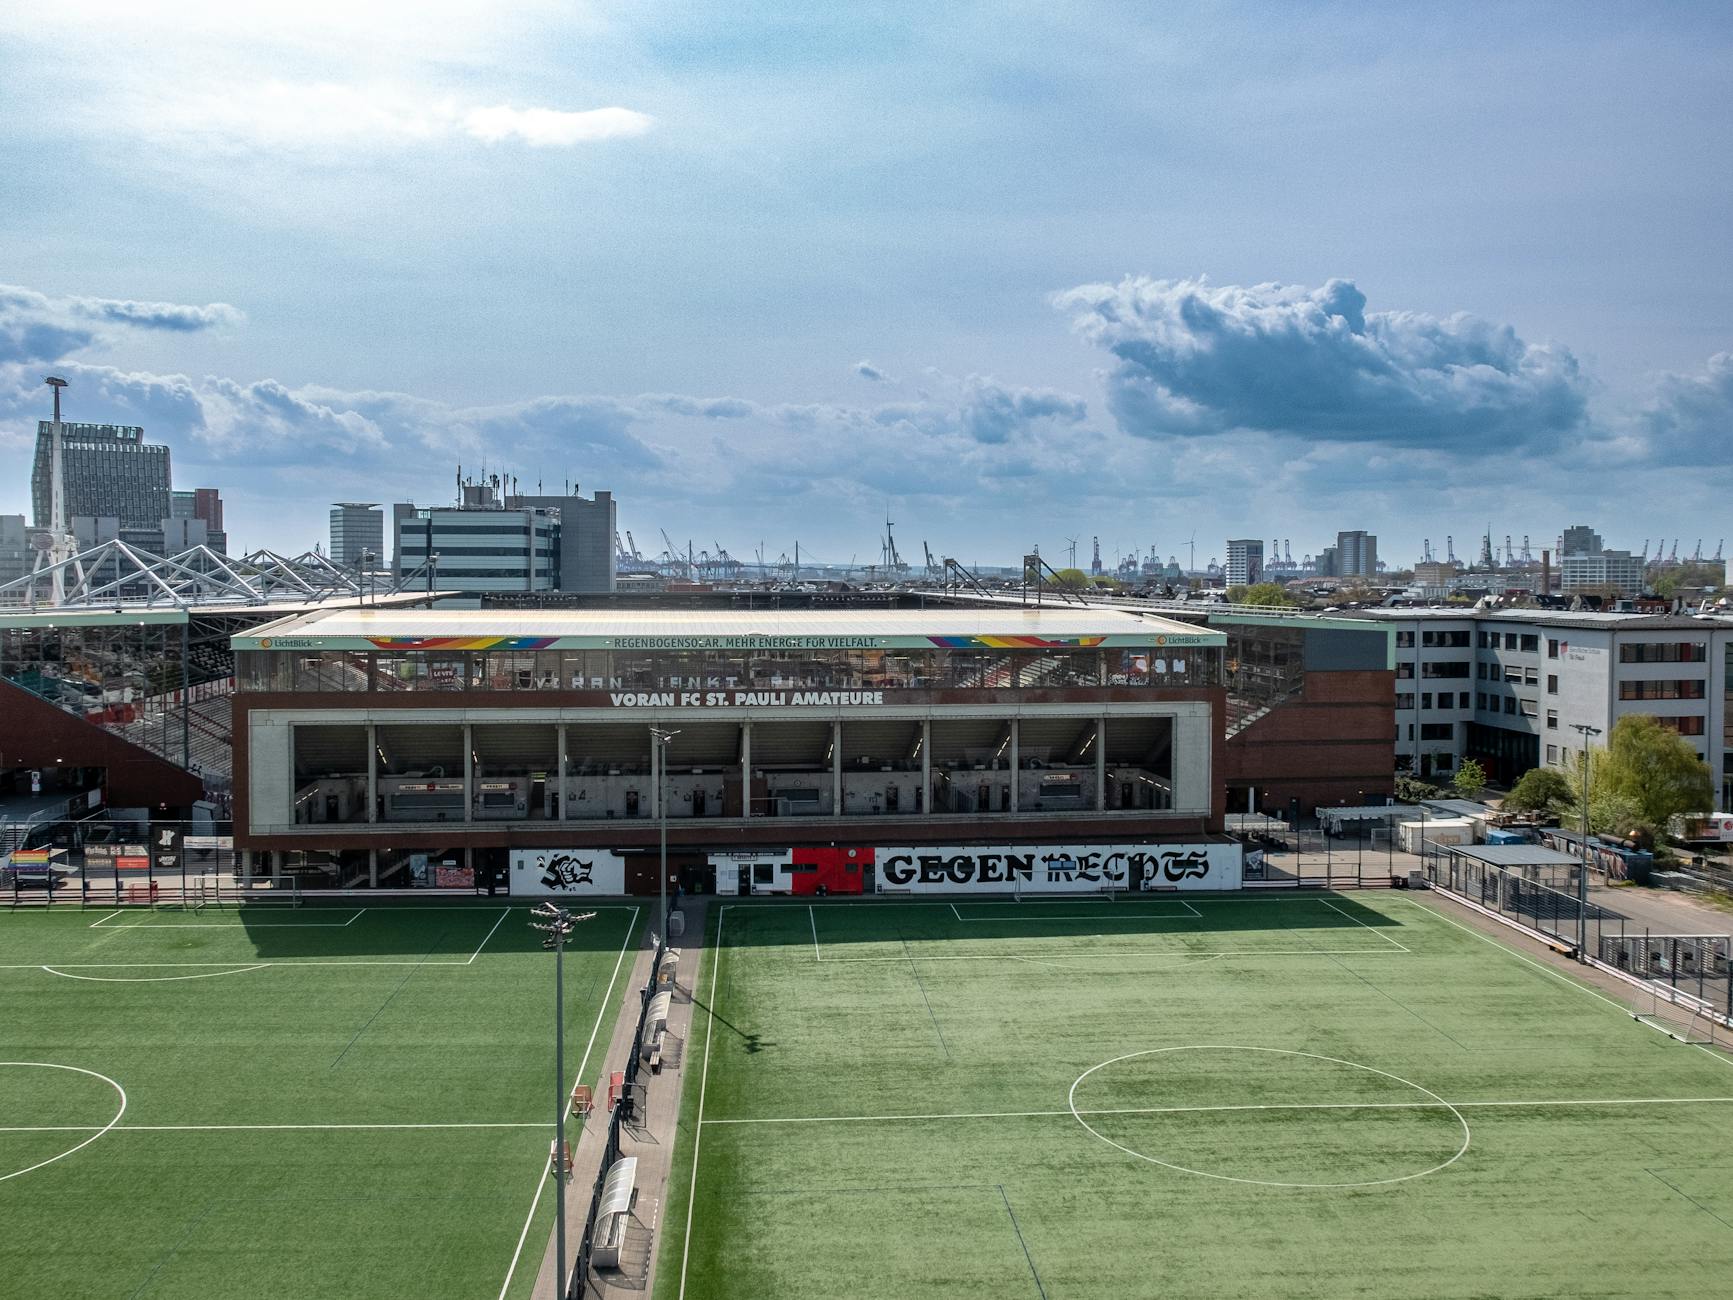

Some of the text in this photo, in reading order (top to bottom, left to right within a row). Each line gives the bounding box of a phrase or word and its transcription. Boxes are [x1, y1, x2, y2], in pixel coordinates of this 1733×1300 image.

[274, 639, 312, 648] LichtBlick
[726, 638, 756, 648] MEHR
[760, 638, 803, 648] ENERGIE
[806, 637, 825, 648] FÜR
[827, 637, 878, 648] VIELFALT.
[1168, 636, 1201, 645] LichtBlick
[610, 691, 883, 707] VORAN FC ST. PAULI AMATEURE
[884, 854, 1036, 885] GEGEN
